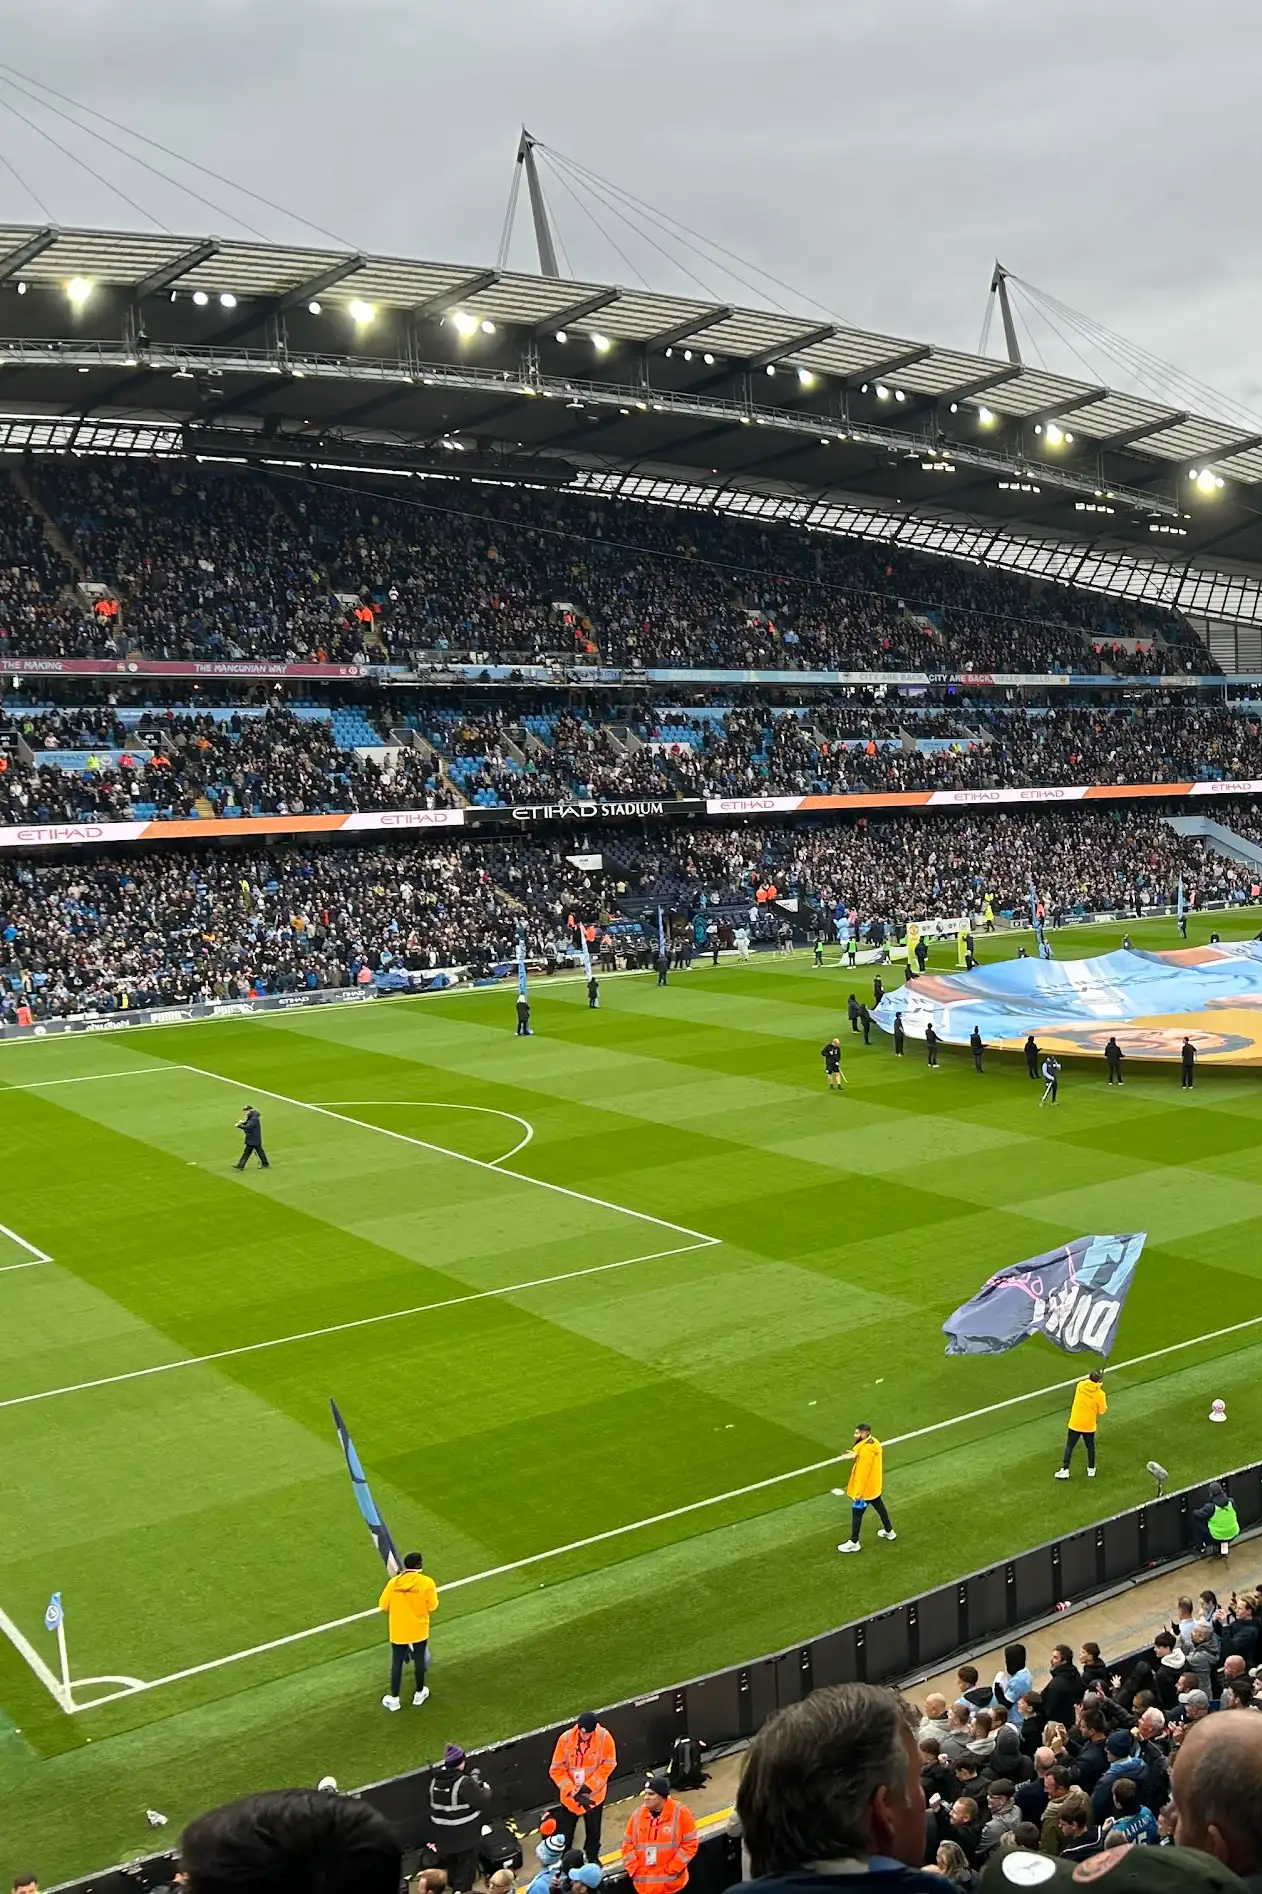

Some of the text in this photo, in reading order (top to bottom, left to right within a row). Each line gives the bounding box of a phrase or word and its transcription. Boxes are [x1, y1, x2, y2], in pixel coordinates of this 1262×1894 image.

[0, 660, 63, 671] THE MAKING
[194, 664, 287, 675] THE MANCUNIAN WAY
[928, 674, 947, 682] CITY
[949, 674, 966, 683] ARE
[1211, 782, 1252, 791] ETIHAD
[953, 791, 1000, 802] ETIHAD
[1020, 790, 1065, 800] ETIHAD
[720, 800, 775, 811] ETIHAD
[512, 802, 664, 821] ETIHAD STADIUM
[379, 813, 448, 825] ETIHAD
[16, 826, 103, 842] ETIHAD
[278, 996, 310, 1005] ETIHAD
